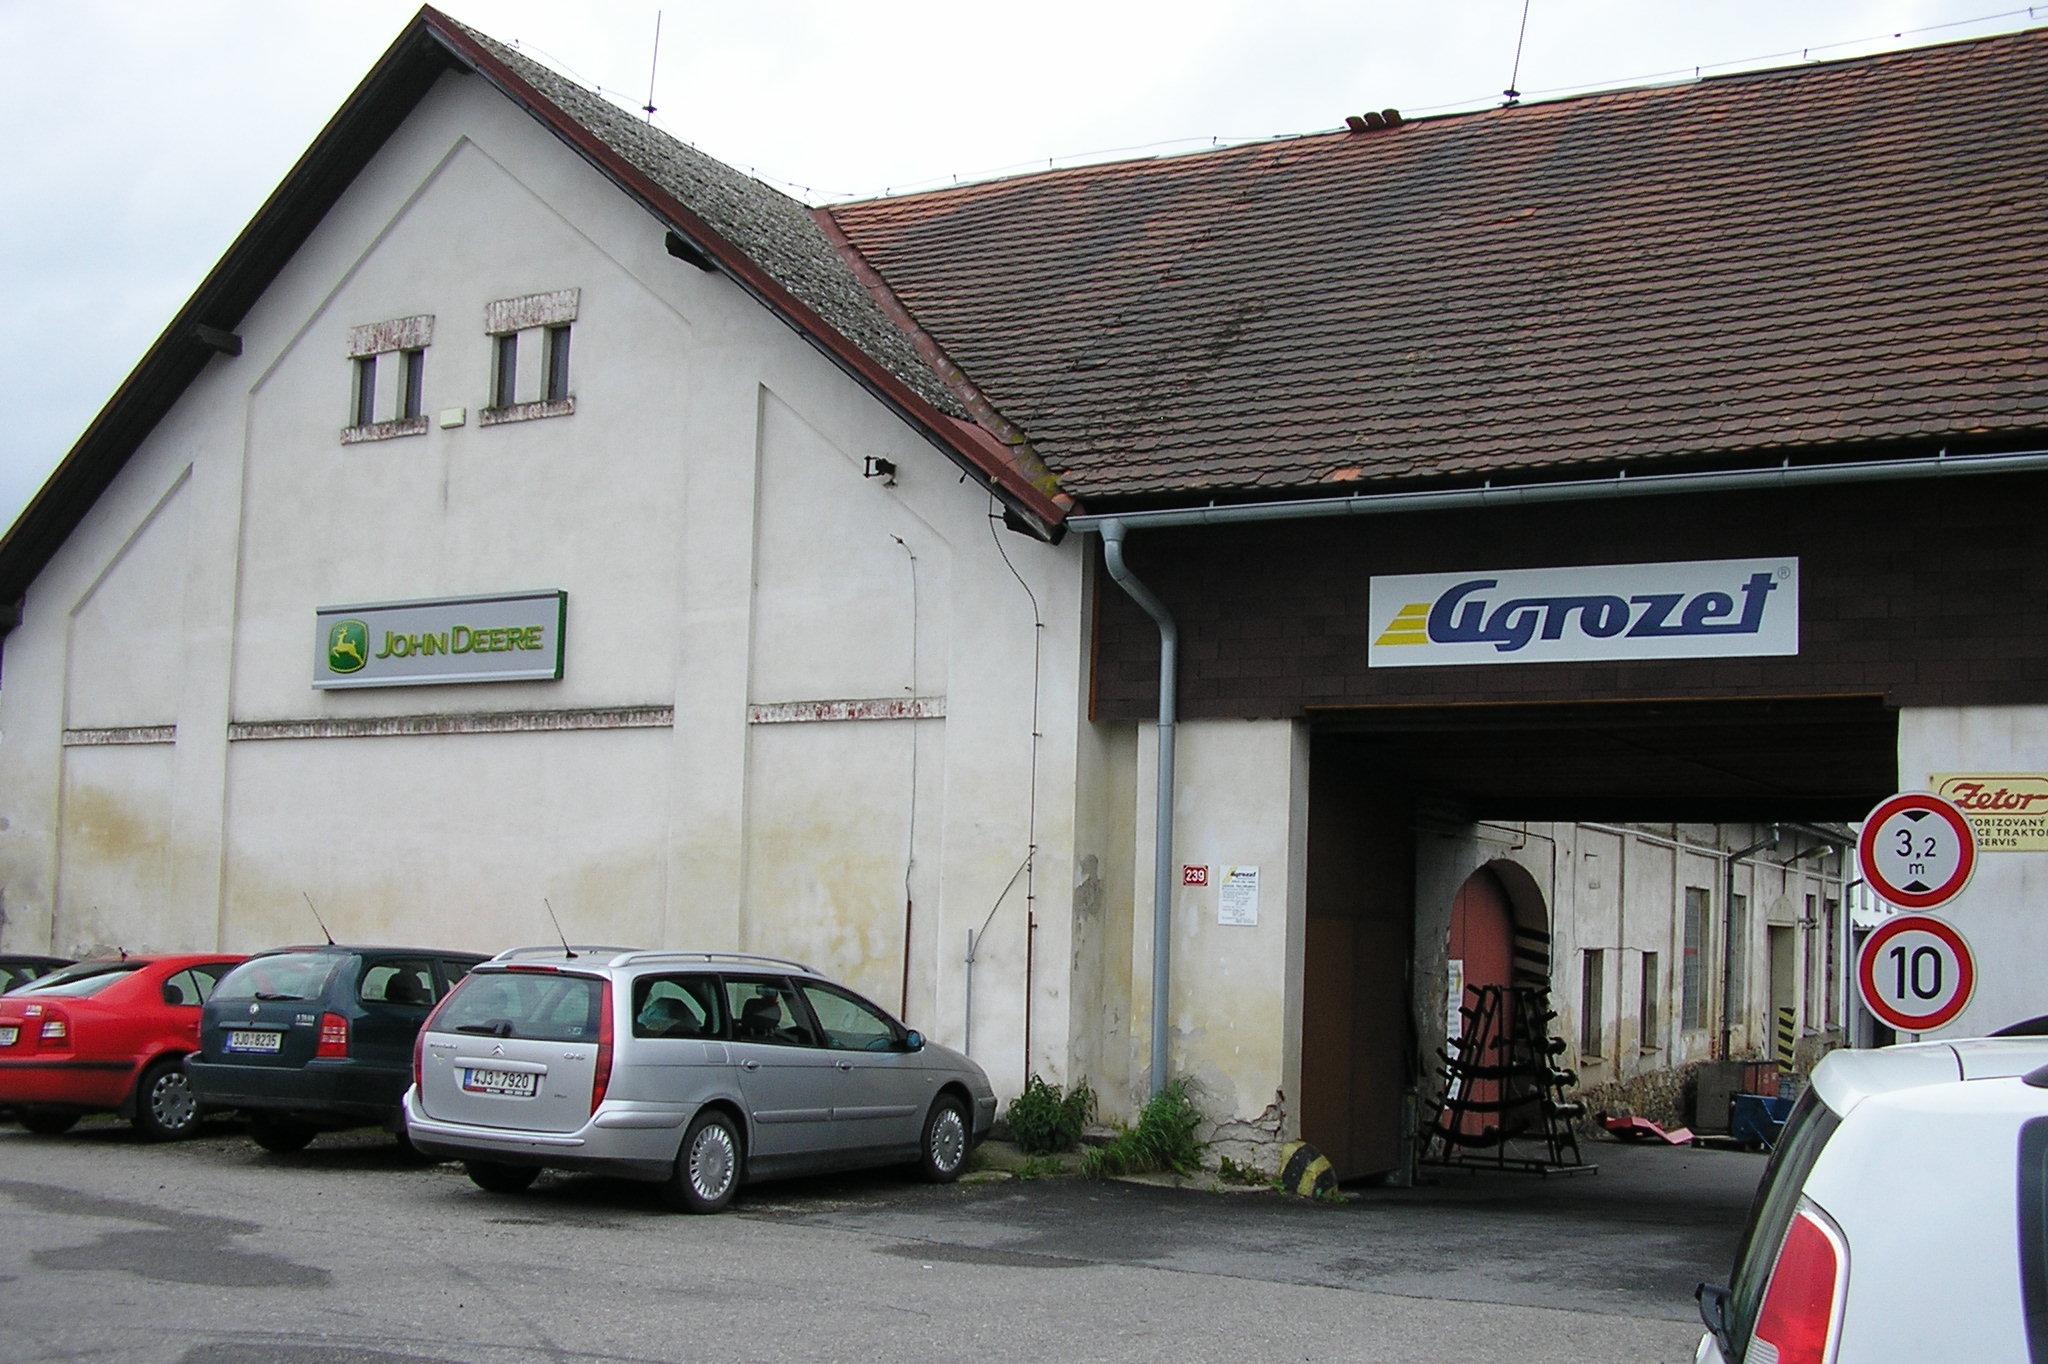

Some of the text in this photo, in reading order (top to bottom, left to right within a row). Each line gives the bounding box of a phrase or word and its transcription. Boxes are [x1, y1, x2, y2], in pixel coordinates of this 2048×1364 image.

[375, 624, 544, 659] JOHN DEERE
[1952, 782, 2048, 810] Zetor
[1895, 829, 1937, 859] 3,2
[1977, 837, 2018, 847] SERVIS
[1185, 869, 1205, 882] 239
[1909, 862, 1925, 875] m
[1890, 946, 1942, 1000] 10
[255, 1033, 277, 1047] 8235
[473, 1069, 529, 1089] 4J3 7920
